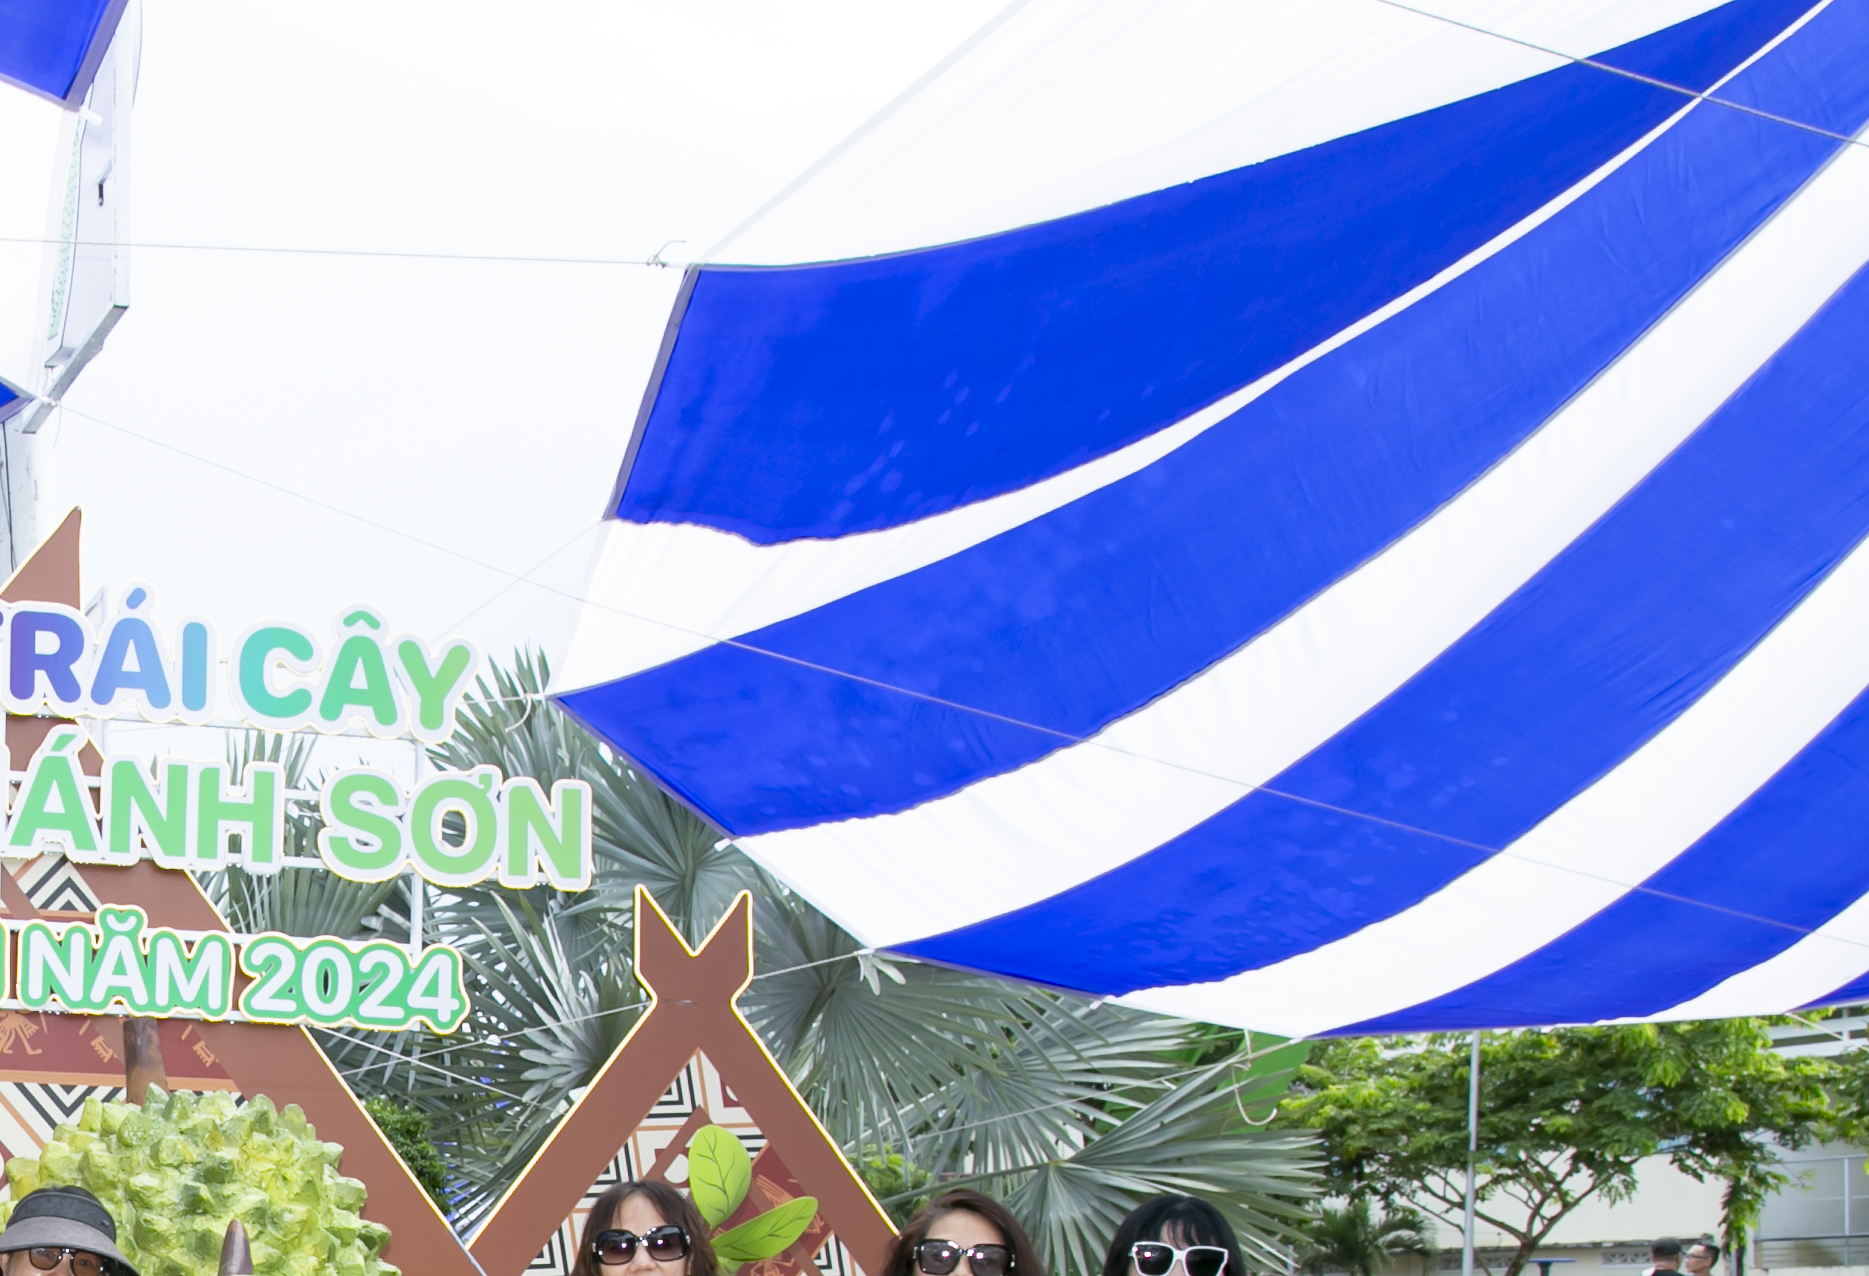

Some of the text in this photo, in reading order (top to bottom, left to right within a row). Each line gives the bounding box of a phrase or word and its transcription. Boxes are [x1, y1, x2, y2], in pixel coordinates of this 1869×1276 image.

[238, 609, 471, 731] CÂY
[327, 773, 583, 880] SƠN
[28, 913, 227, 1017] NĂM
[249, 940, 462, 1024] 2024
